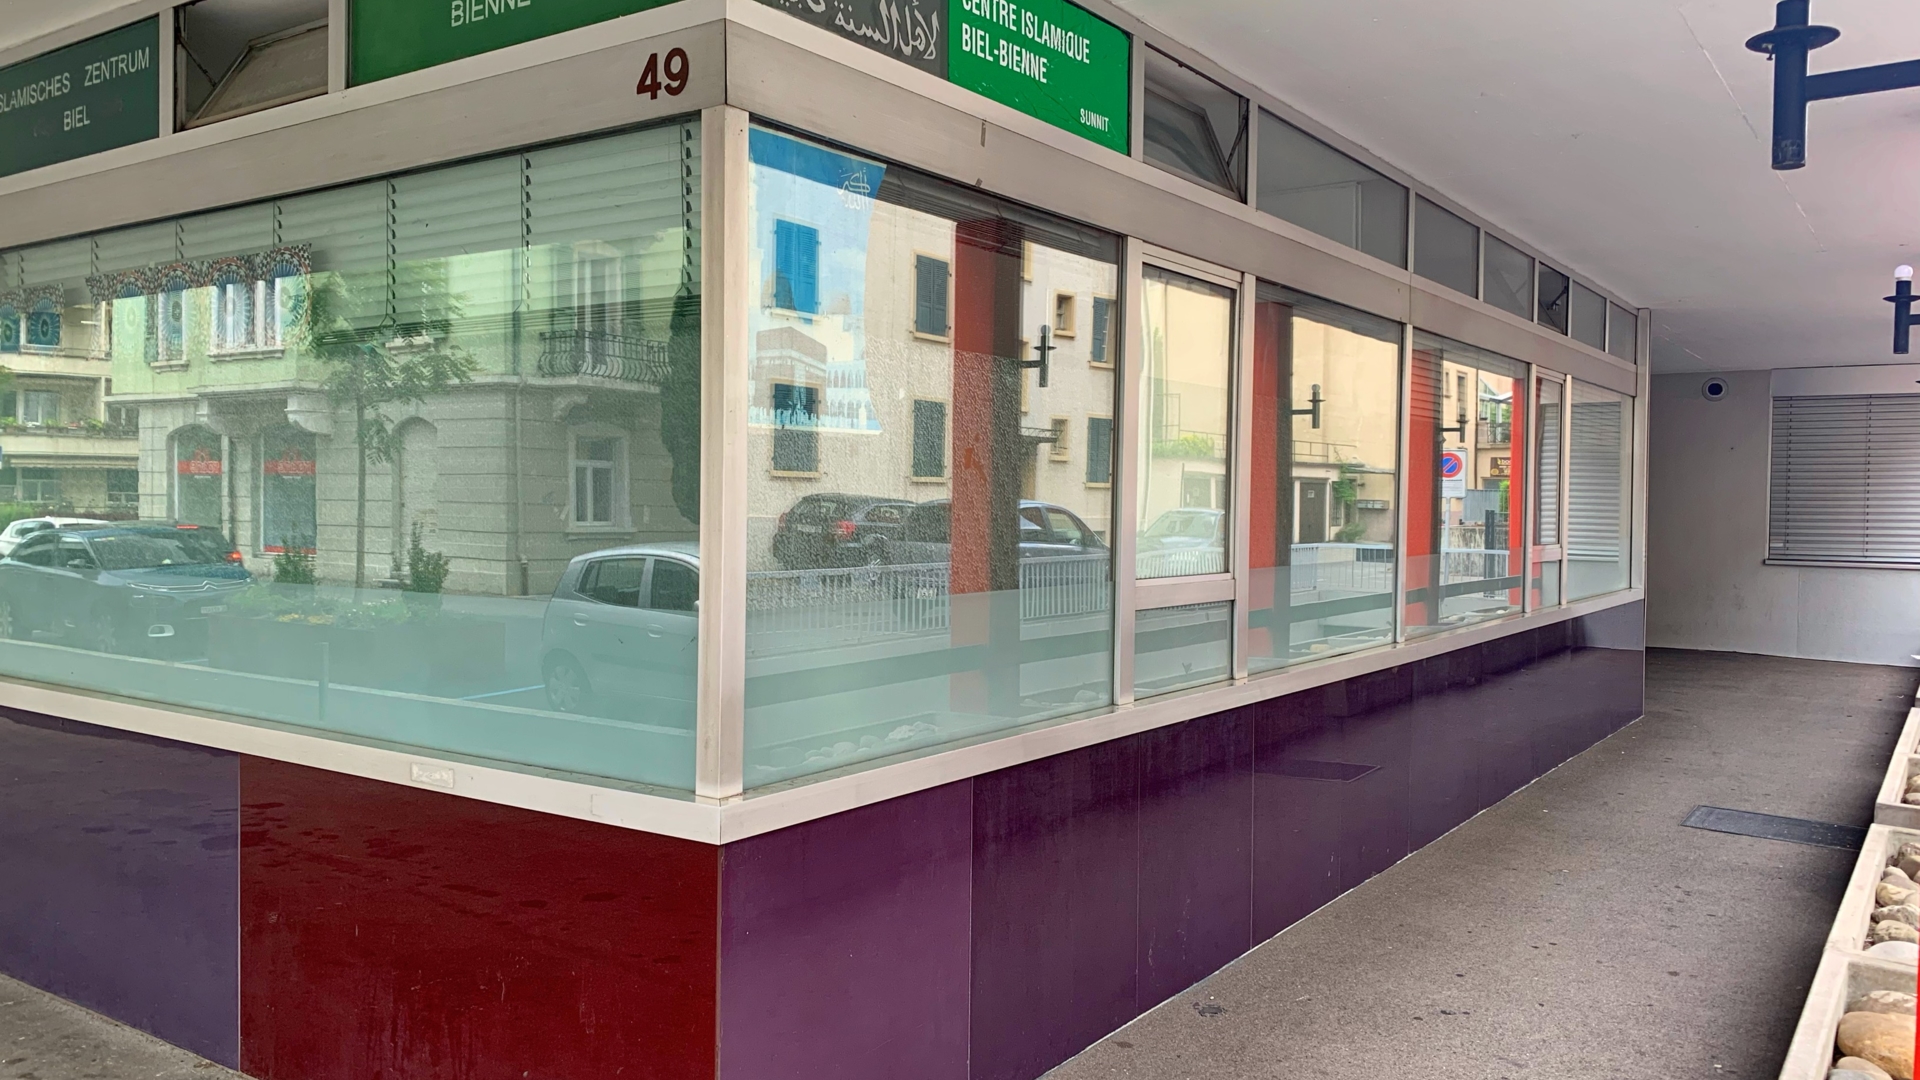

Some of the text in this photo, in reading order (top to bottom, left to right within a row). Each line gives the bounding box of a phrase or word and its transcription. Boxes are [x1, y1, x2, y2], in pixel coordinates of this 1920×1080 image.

[451, 0, 531, 28] BIEN
[961, 22, 1048, 84] BIEL-BIENNE
[1021, 8, 1090, 65] ISLAMIQUE
[84, 46, 150, 87] ZENTRUM
[636, 47, 690, 100] 49
[63, 105, 91, 131] BIEL
[1080, 107, 1109, 132] SUNNIT
